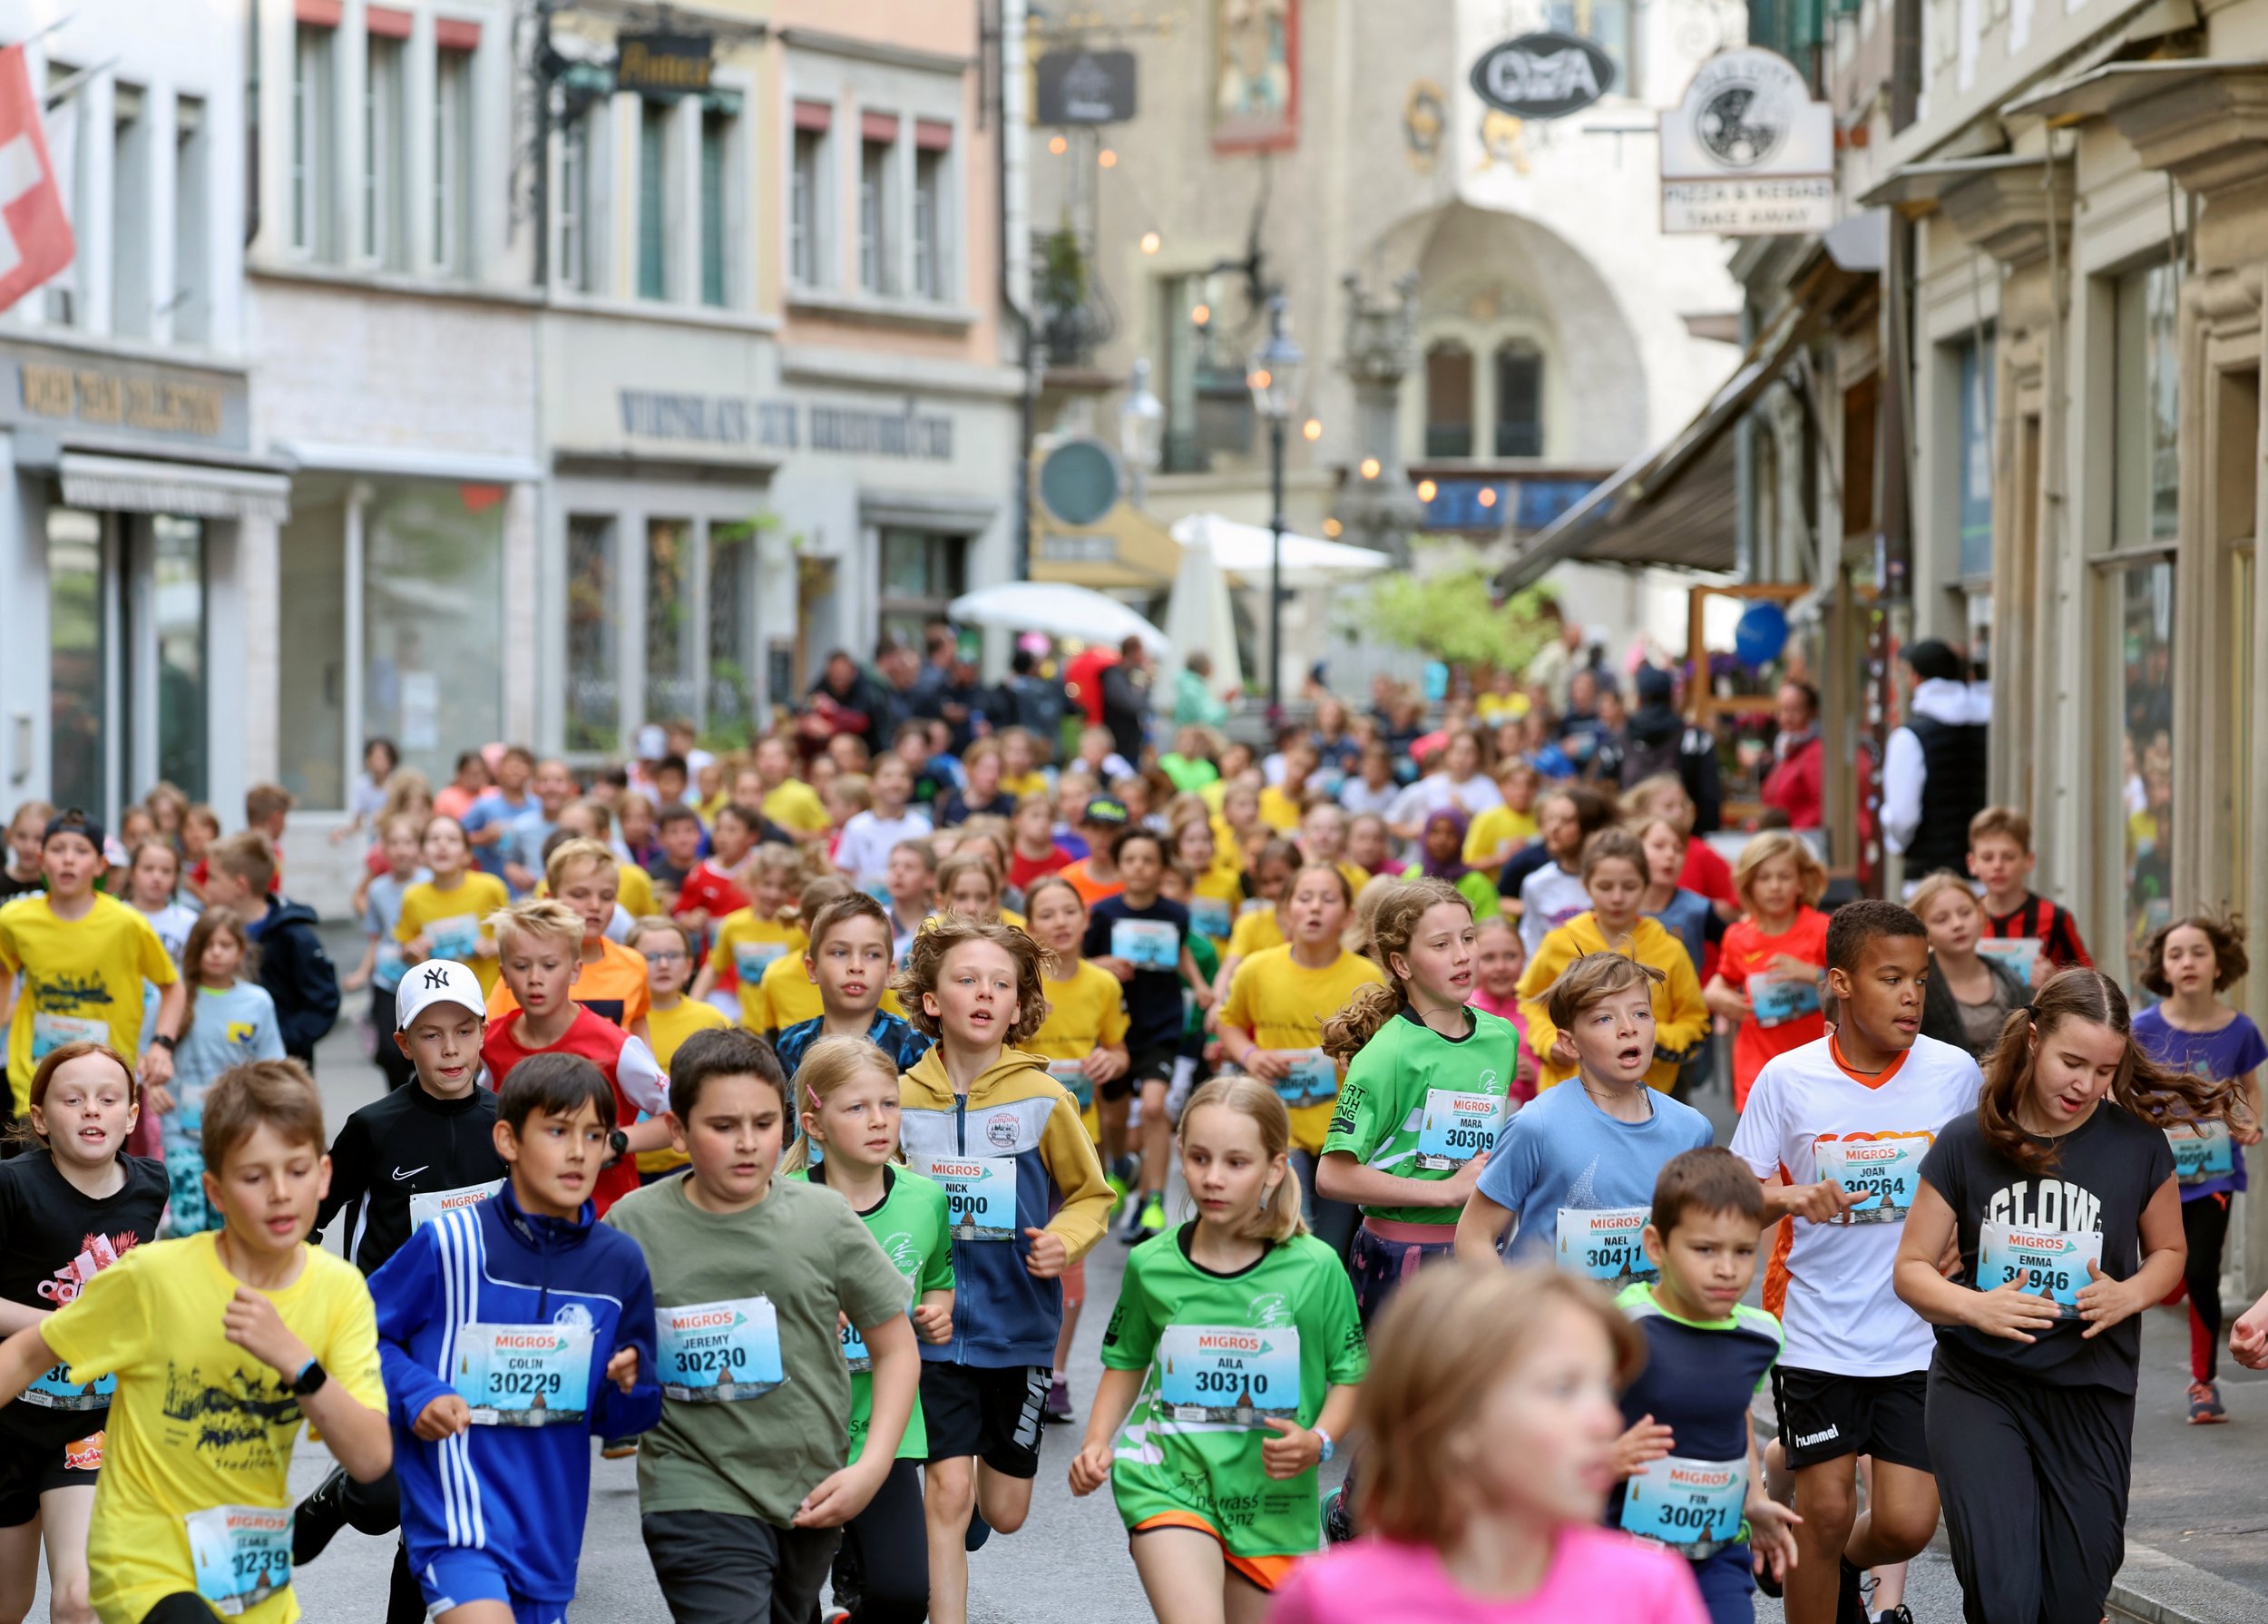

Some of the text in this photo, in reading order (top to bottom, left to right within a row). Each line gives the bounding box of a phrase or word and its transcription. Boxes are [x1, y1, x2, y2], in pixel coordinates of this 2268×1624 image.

[424, 967, 450, 989] NY
[1453, 1101, 1491, 1112] MIGROS
[988, 1117, 1019, 1125] Camping
[1460, 1118, 1482, 1129] MARA
[1445, 1130, 1494, 1150] 30309
[1846, 1149, 1895, 1160] MIGROS
[933, 1164, 981, 1176] MIGROS
[1860, 1167, 1885, 1178] JOAN
[946, 1183, 968, 1193] NICK
[1844, 1178, 1905, 1197] 30264
[441, 1192, 485, 1209] MIGROS
[1990, 1179, 2101, 1233] GLOW
[1590, 1217, 1640, 1228] MIGROS
[1604, 1236, 1628, 1247] NAEL
[2009, 1234, 2063, 1249] MIGROS
[1586, 1245, 1642, 1267] 30411
[2019, 1255, 2052, 1267] EMMA
[672, 1312, 733, 1330] MIGROS
[495, 1335, 555, 1348] MIGROS
[683, 1335, 729, 1349] JEREMY
[1198, 1336, 1258, 1350] MIGROS
[509, 1358, 543, 1370] COLIN
[675, 1347, 746, 1373] 30230
[1217, 1358, 1243, 1370] AILA
[489, 1373, 561, 1394] 30229
[1195, 1372, 1267, 1394] 30310
[1795, 1423, 1839, 1448] hummel
[1670, 1469, 1729, 1485] MIGROS
[1689, 1494, 1709, 1505] FIN
[226, 1514, 286, 1529] MIGROS
[1658, 1504, 1726, 1529] 30021
